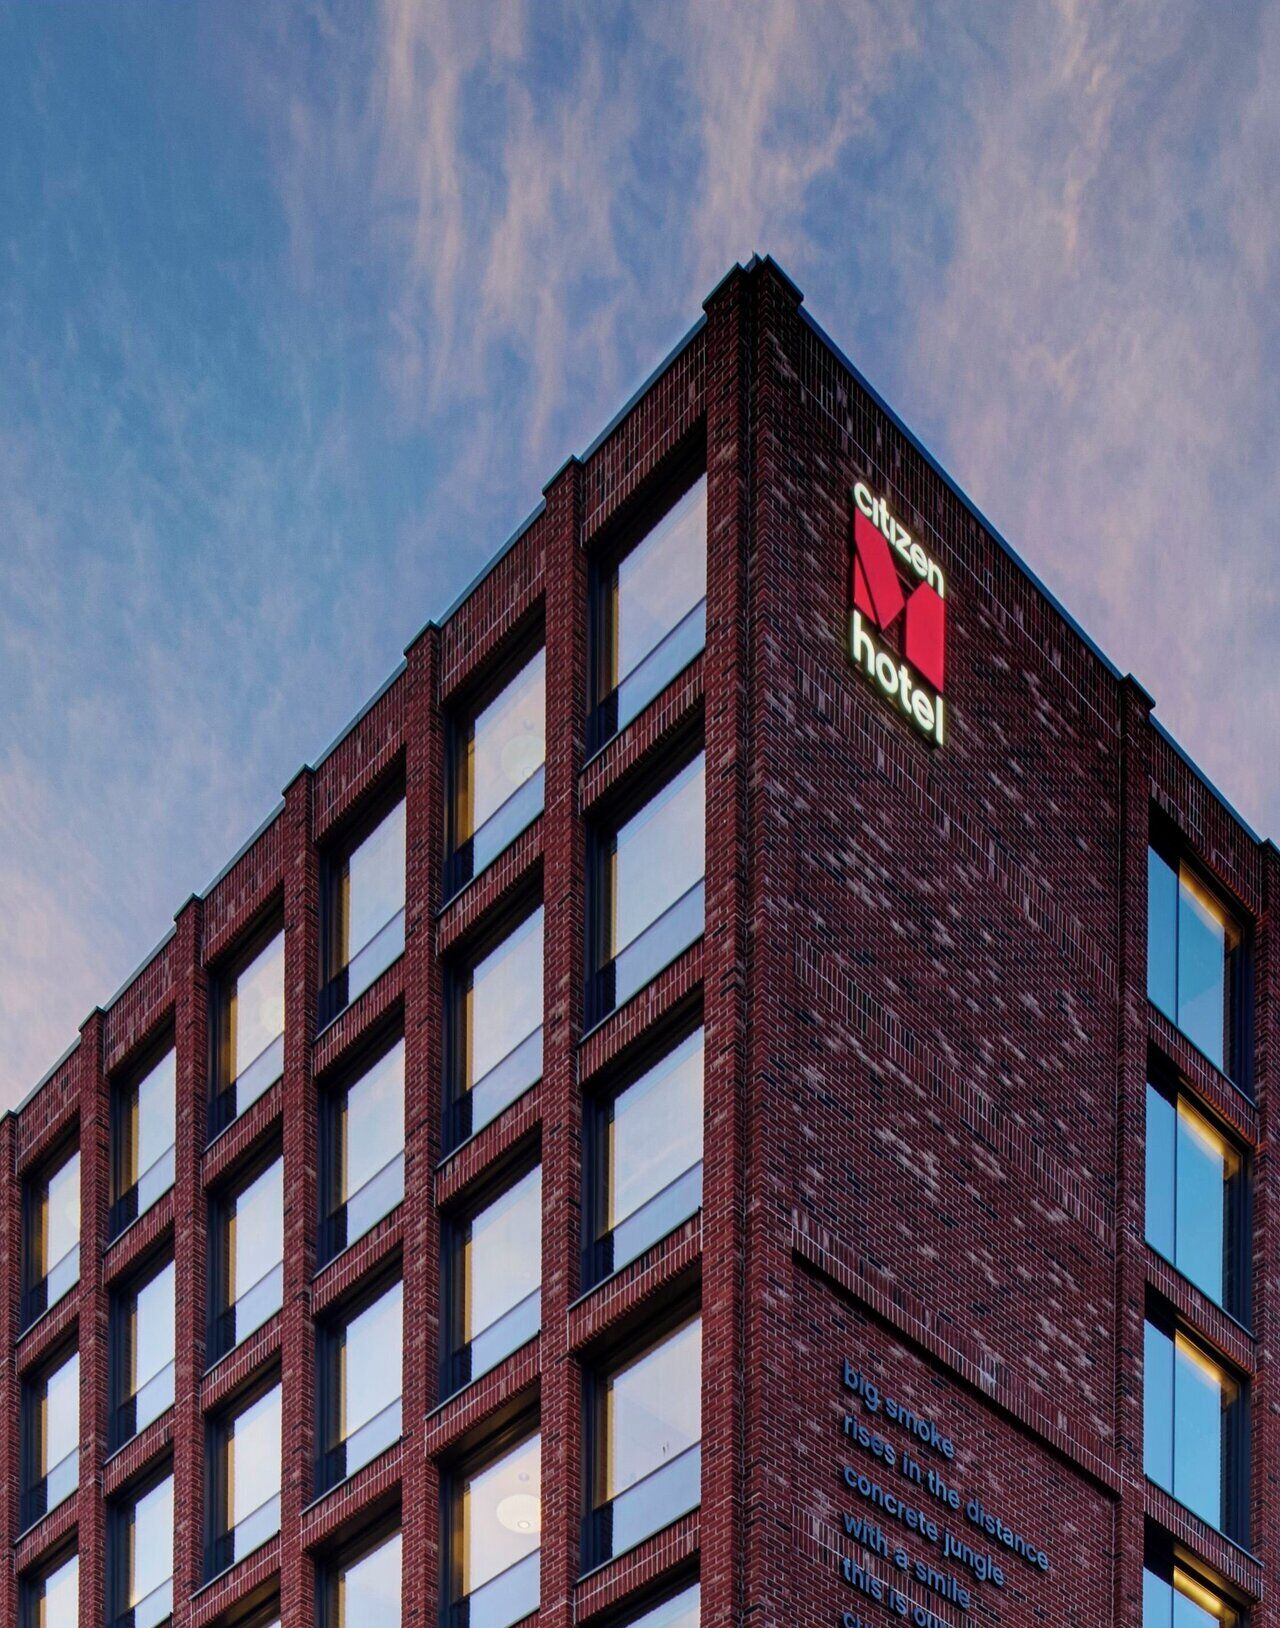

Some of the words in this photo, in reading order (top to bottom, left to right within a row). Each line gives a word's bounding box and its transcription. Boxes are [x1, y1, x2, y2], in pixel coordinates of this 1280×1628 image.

[853, 482, 945, 599] citizen
[853, 608, 944, 746] hotel
[842, 1357, 880, 1411] big
[885, 1398, 955, 1459] smoke
[842, 1414, 896, 1466] rises
[902, 1451, 921, 1485] in
[927, 1471, 961, 1510] the
[966, 1499, 1050, 1571] distance
[842, 1465, 939, 1542] concrete
[942, 1527, 1005, 1588] jungle
[842, 1512, 888, 1557] with
[894, 1548, 909, 1571] a
[915, 1561, 970, 1611] smile
[842, 1557, 883, 1600] this
[888, 1586, 908, 1616] is
